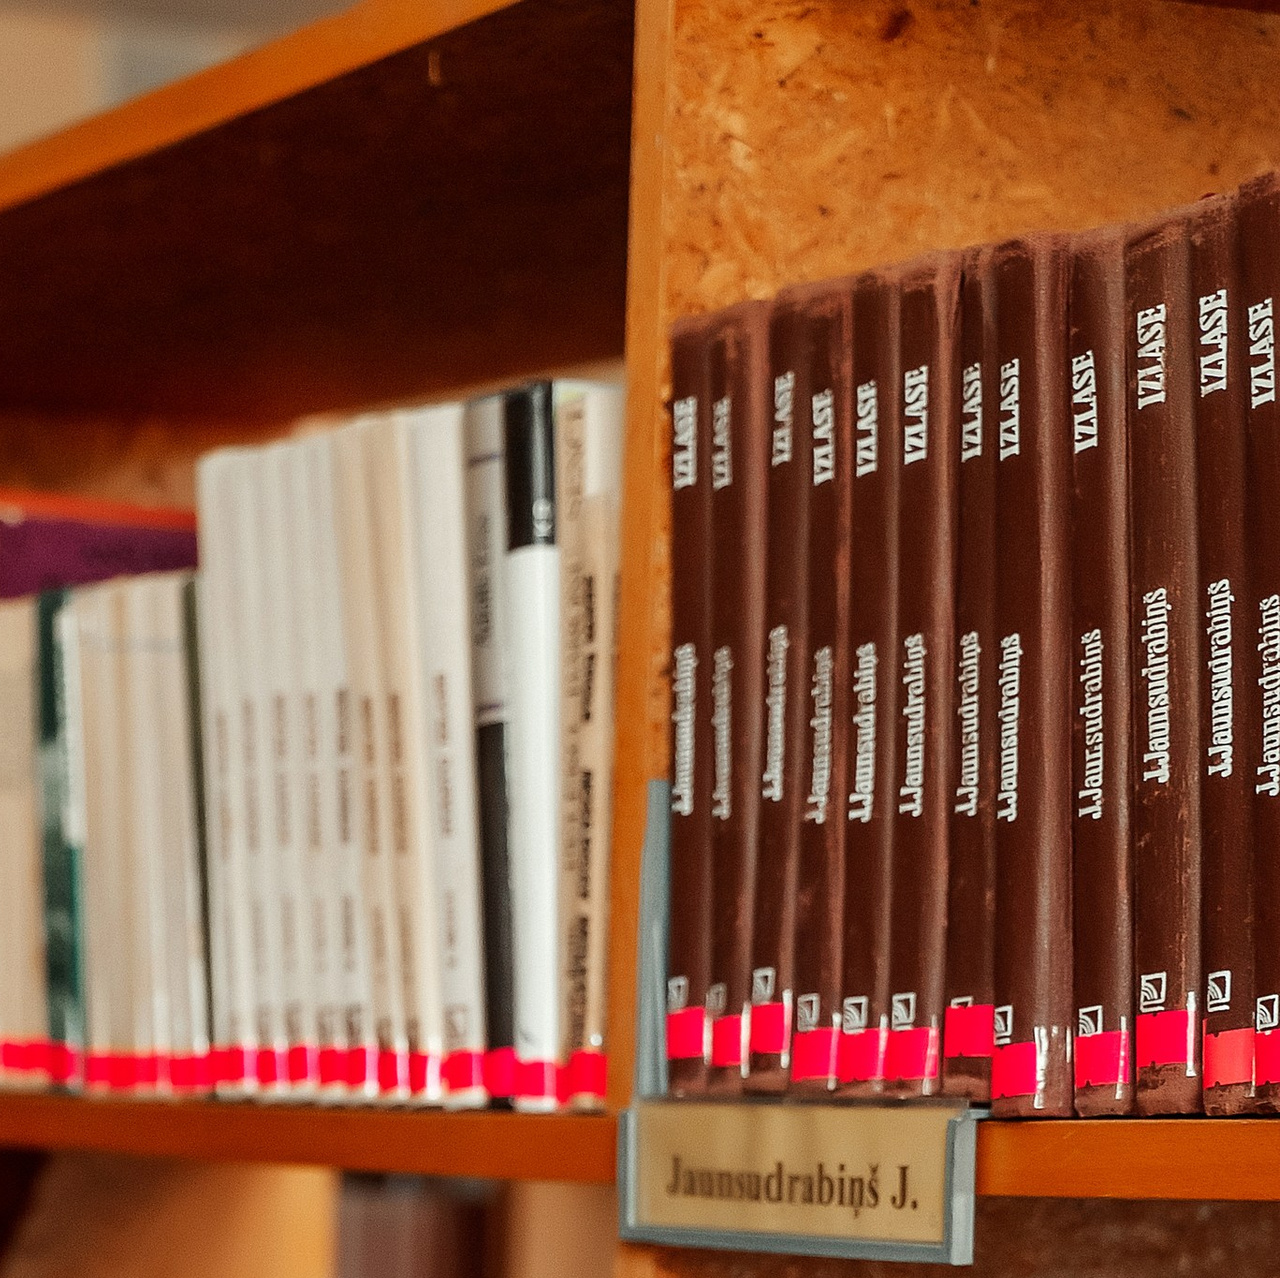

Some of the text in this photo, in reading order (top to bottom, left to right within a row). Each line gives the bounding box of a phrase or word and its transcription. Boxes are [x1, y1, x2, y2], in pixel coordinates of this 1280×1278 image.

[1137, 303, 1166, 410] IZLASE
[1199, 289, 1227, 397] IZLASE
[1248, 297, 1275, 409] IZLASE
[812, 388, 835, 486] IZLASE
[856, 380, 877, 478] IZLASE
[904, 364, 929, 466] IZLASE
[961, 362, 982, 463] IZLASE
[1000, 358, 1020, 461] IZLASE
[1072, 350, 1098, 454] IZLASE
[890, 1164, 918, 1211] J.
